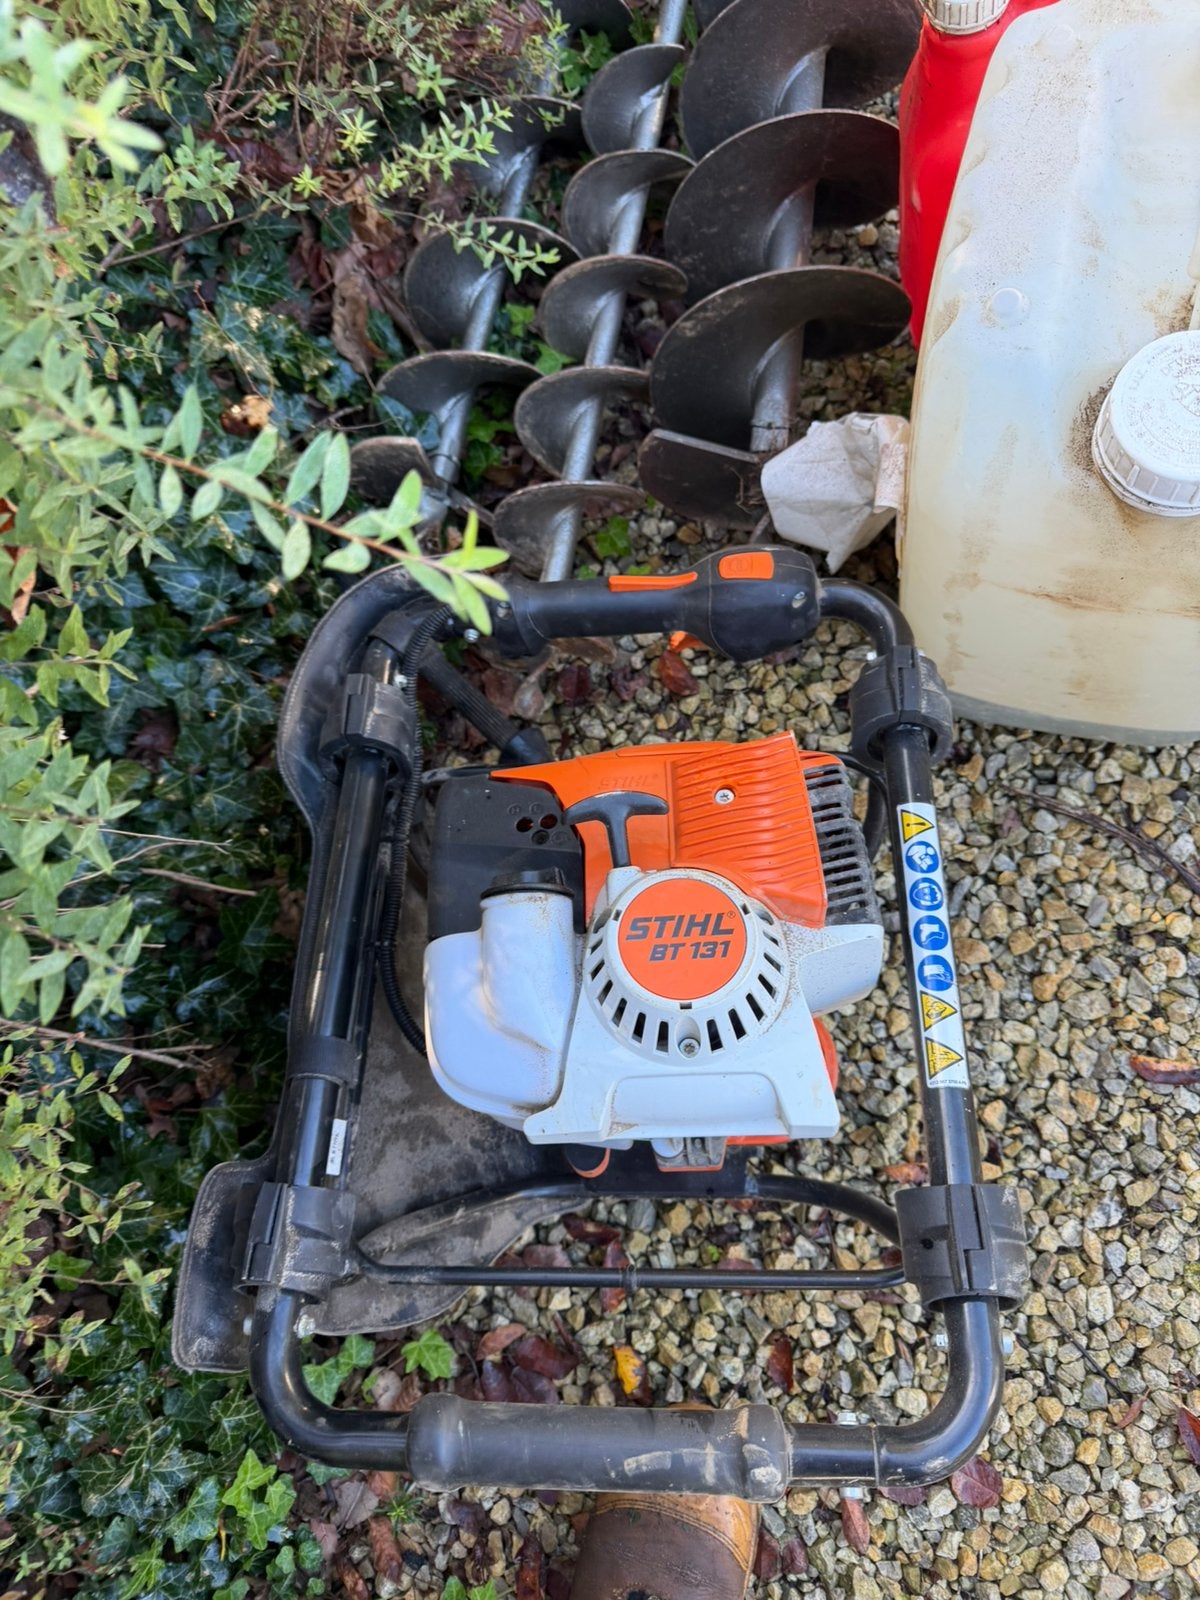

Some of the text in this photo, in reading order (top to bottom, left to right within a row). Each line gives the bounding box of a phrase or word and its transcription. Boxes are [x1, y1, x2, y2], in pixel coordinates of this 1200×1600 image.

[625, 912, 735, 941] STIHL
[649, 940, 731, 962] BT 131
